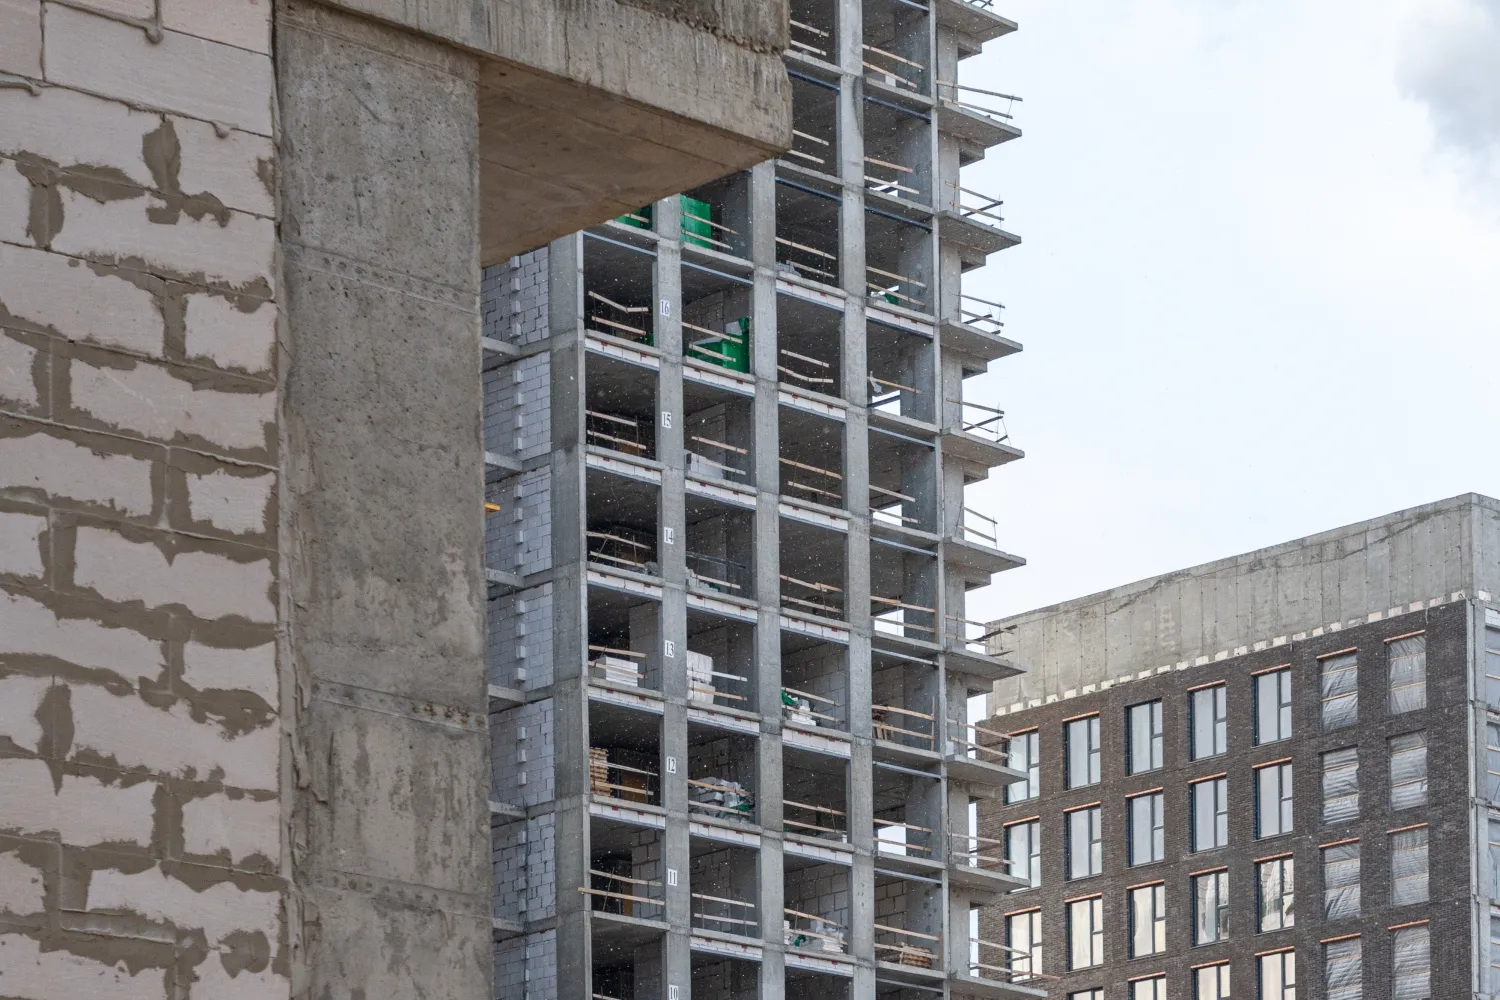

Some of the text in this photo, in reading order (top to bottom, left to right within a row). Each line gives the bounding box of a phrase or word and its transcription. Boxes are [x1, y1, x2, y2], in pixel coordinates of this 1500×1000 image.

[661, 300, 670, 316] 16
[663, 412, 671, 427] 15
[665, 528, 673, 543] 14
[666, 641, 674, 657] 13
[667, 757, 675, 773] 12
[669, 869, 676, 885] 11
[669, 985, 678, 1000] 10
